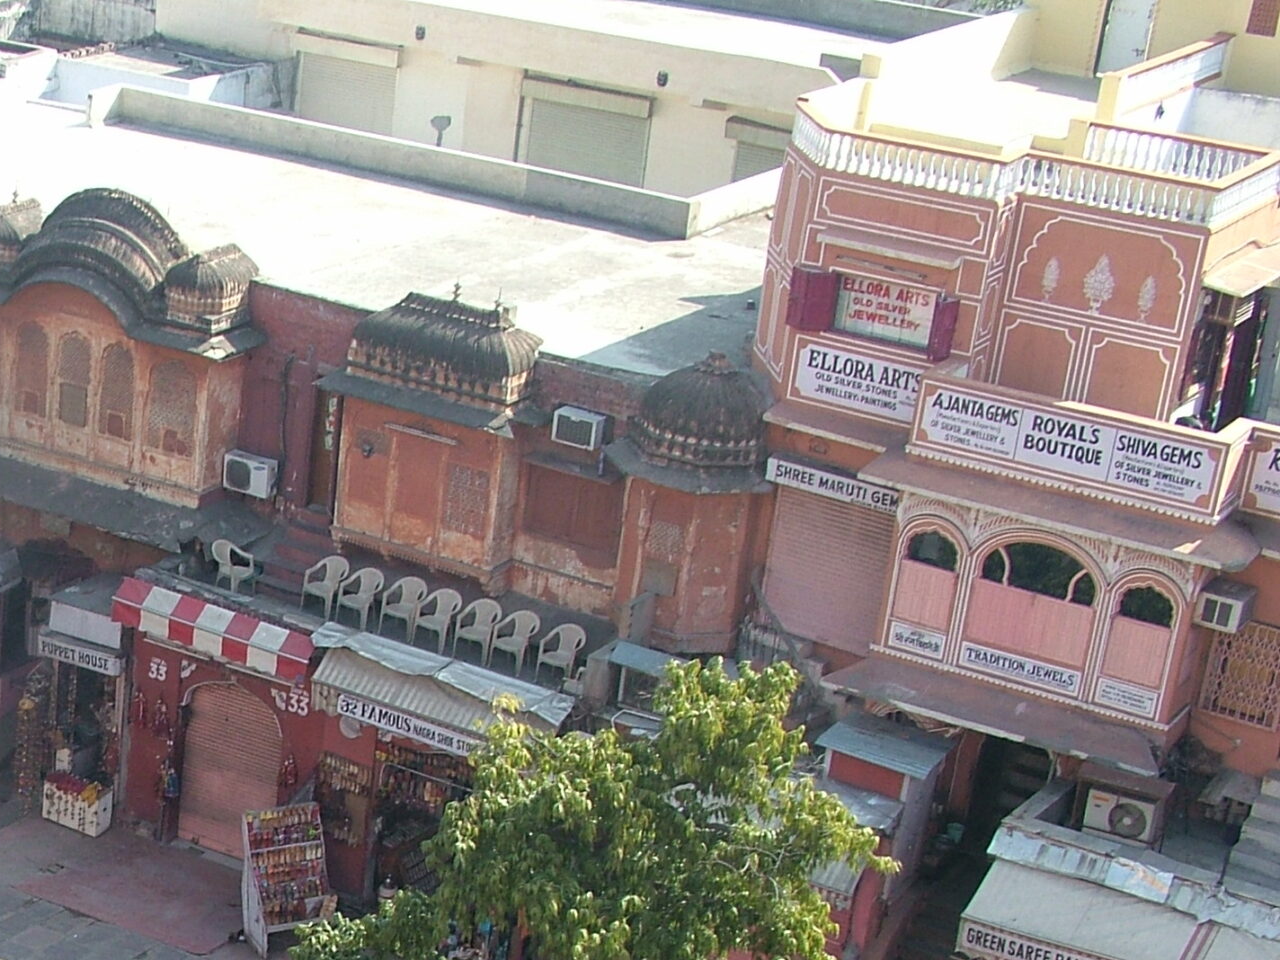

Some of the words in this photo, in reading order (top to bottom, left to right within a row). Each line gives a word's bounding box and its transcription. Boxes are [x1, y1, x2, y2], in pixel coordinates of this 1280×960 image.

[842, 277, 890, 299] ELLORA
[896, 288, 930, 307] ARTS
[852, 297, 873, 308] OLD
[848, 310, 920, 331] JEWELLERY
[807, 349, 874, 382] ELLORA
[879, 366, 921, 393] ARTS
[815, 371, 832, 383] OLD
[932, 393, 984, 419] AJANTA
[985, 405, 1019, 427] GEMS
[1023, 433, 1103, 466] BOUTIQUE
[1116, 435, 1158, 460] SHIVA
[1160, 444, 1204, 469] GEMS
[775, 464, 816, 486] SHREE
[818, 476, 868, 500] MARUTI
[41, 640, 76, 662] PUPPET
[78, 650, 109, 672] HOUSE
[148, 661, 168, 681] 33
[966, 647, 1026, 673] TRADITION
[1027, 665, 1075, 687] JEWELS
[288, 692, 310, 717] 33
[360, 703, 413, 733] FAMOUS
[966, 927, 1006, 953] GREEN
